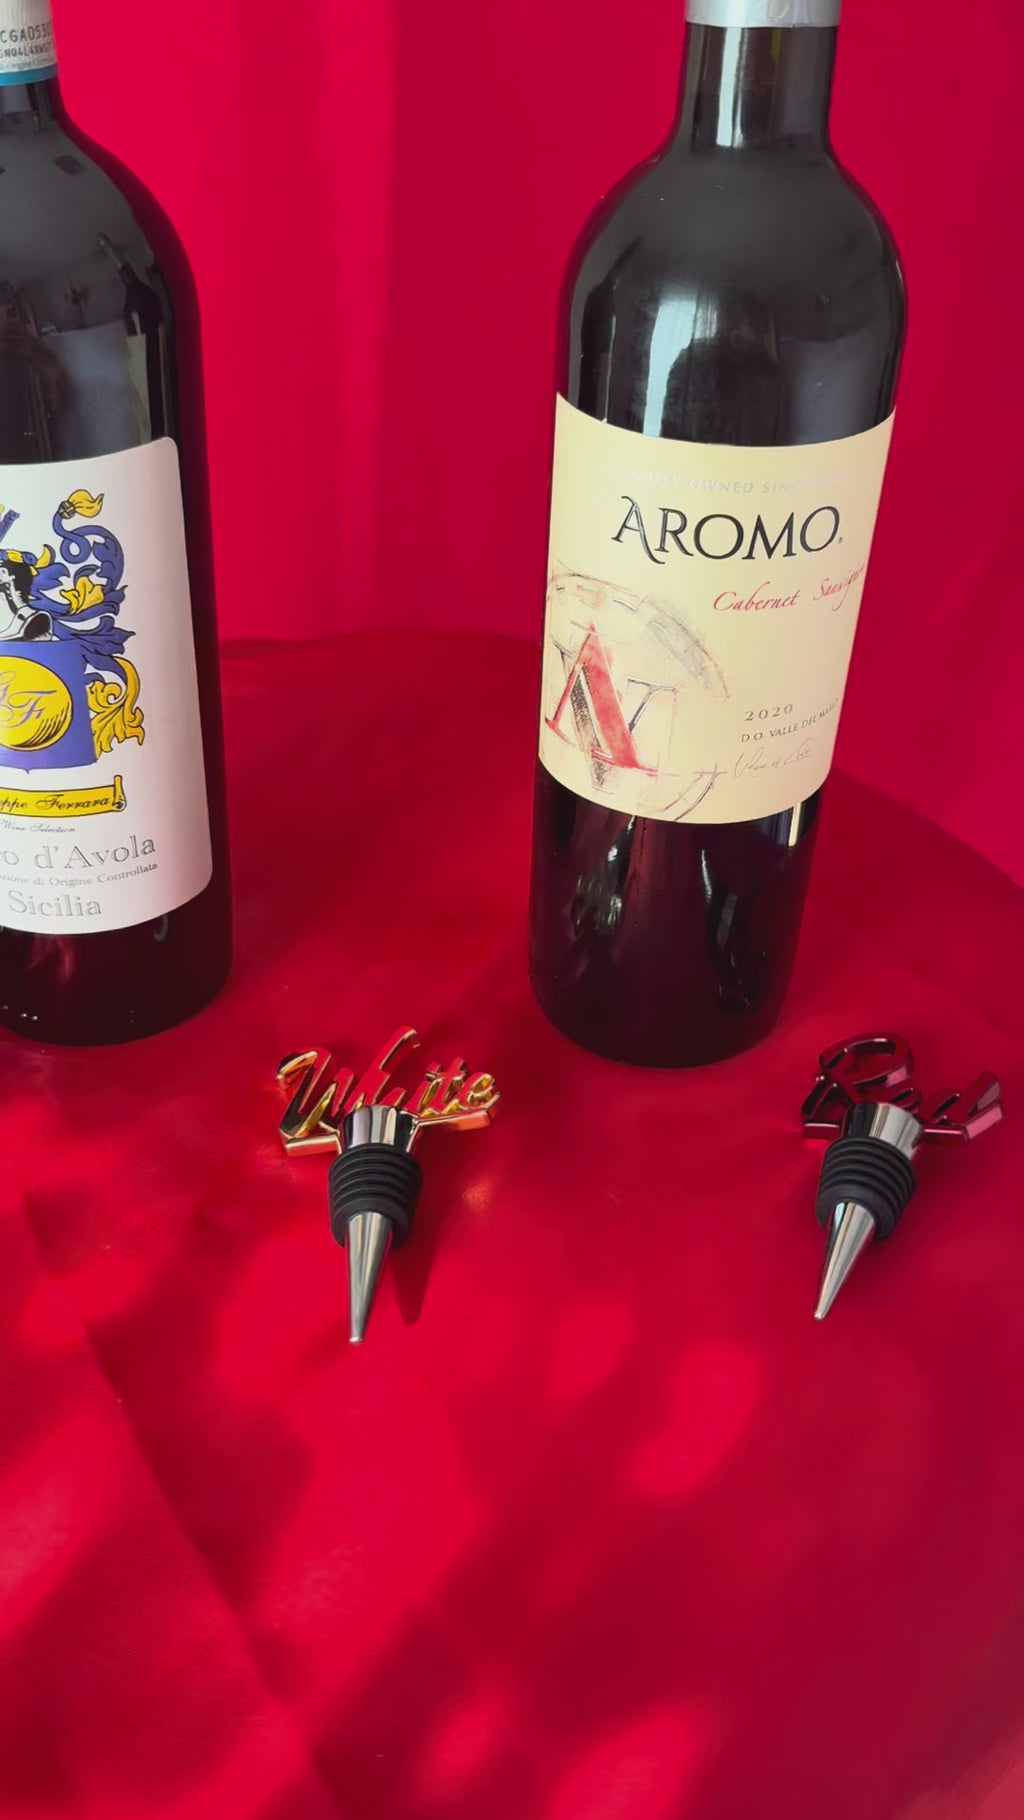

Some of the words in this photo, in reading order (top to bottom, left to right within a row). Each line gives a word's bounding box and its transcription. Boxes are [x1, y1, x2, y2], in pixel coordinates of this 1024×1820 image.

[611, 495, 840, 565] AROMO
[712, 581, 800, 612] Cabernet
[744, 703, 794, 722] 2020
[769, 722, 800, 738] VALLE
[35, 793, 109, 811] Ferrara
[30, 823, 76, 833] Selection
[33, 834, 156, 870] d'Avola
[33, 876, 45, 886] di
[49, 876, 93, 888] Origine
[97, 862, 158, 884] Controllata
[8, 889, 102, 918] Sicilia
[276, 1024, 501, 1157] White
[801, 1031, 1004, 1143] Red
